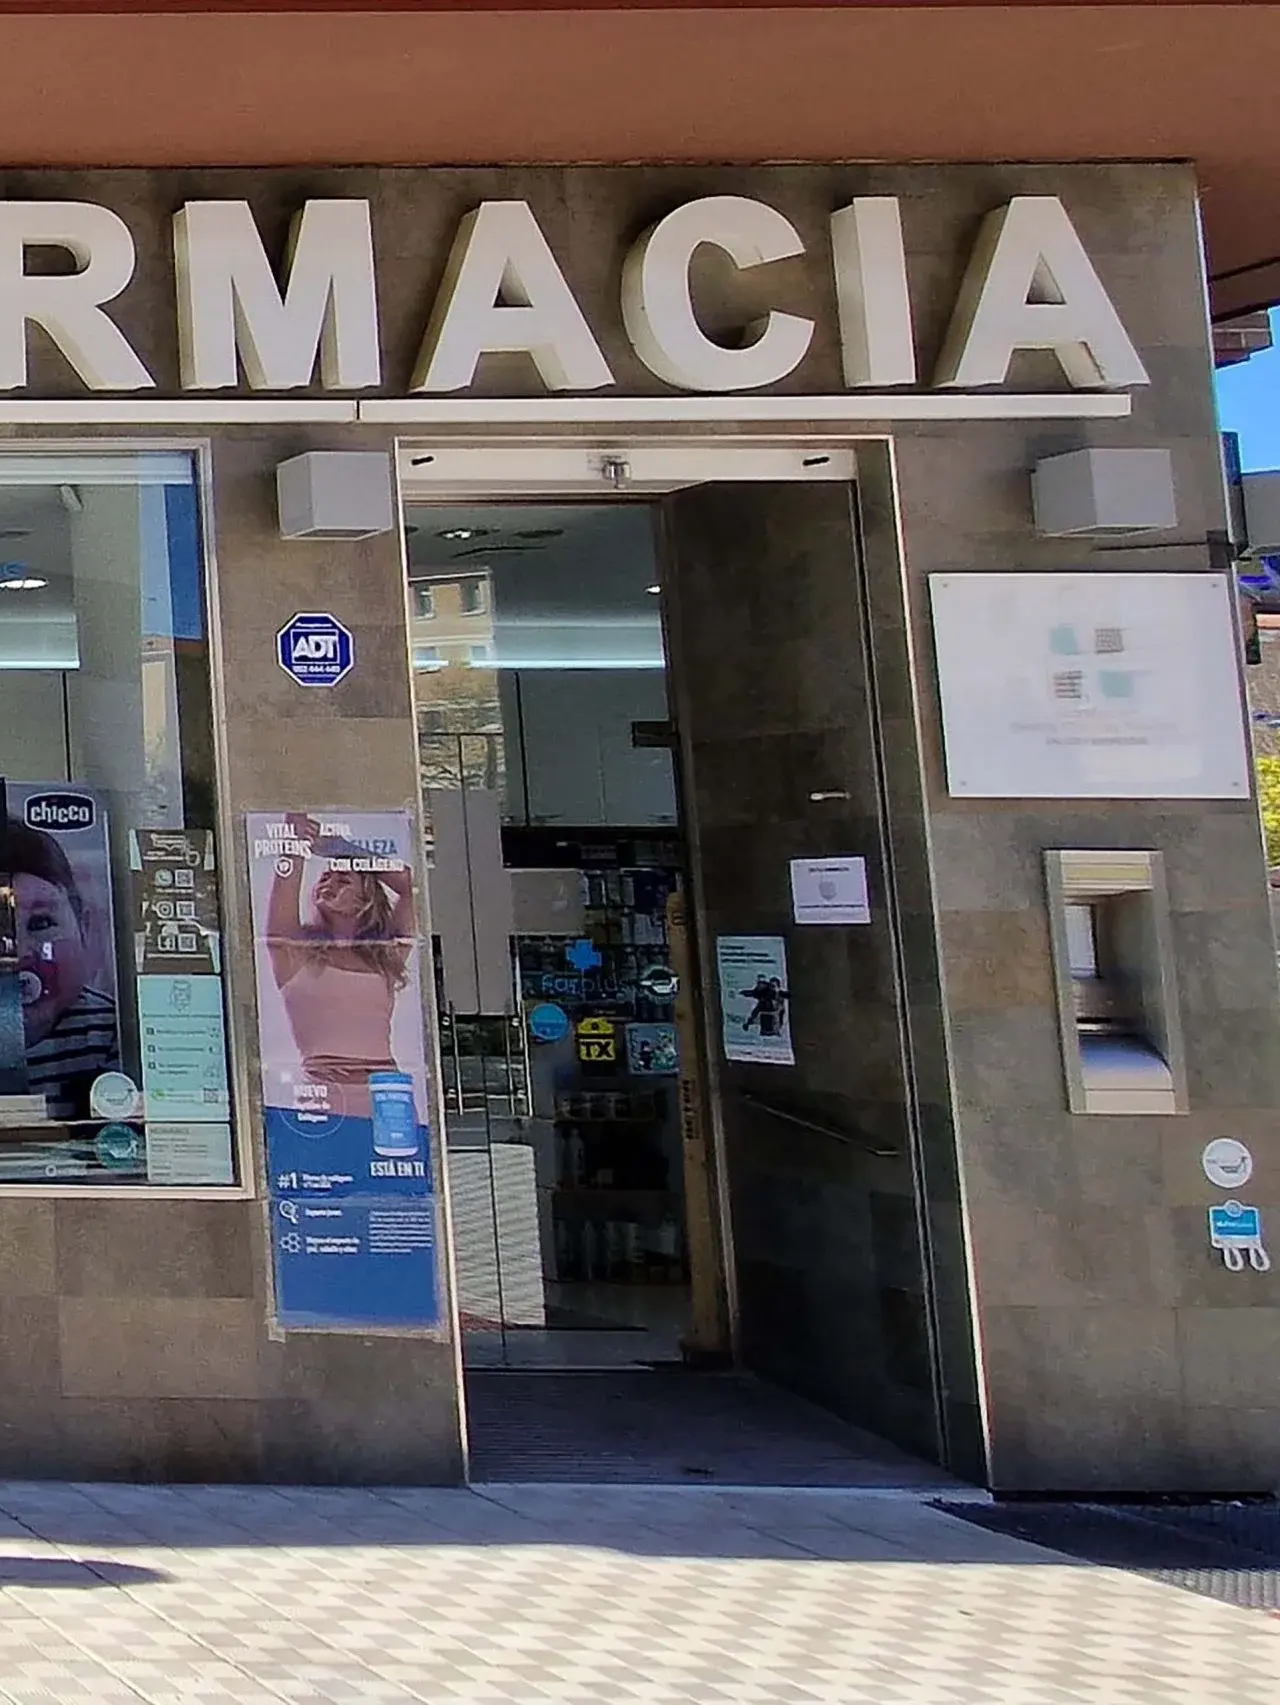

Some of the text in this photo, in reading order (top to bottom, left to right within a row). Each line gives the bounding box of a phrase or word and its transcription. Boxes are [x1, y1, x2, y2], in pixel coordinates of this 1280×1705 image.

[293, 635, 338, 658] ADT
[30, 799, 90, 823] chicco
[266, 823, 298, 839] VITAL
[254, 838, 312, 859] PROTEINS
[581, 1041, 614, 1058] TX
[370, 1159, 396, 1176] ESTÁ
[397, 1161, 413, 1176] EN
[277, 1172, 298, 1189] #1
